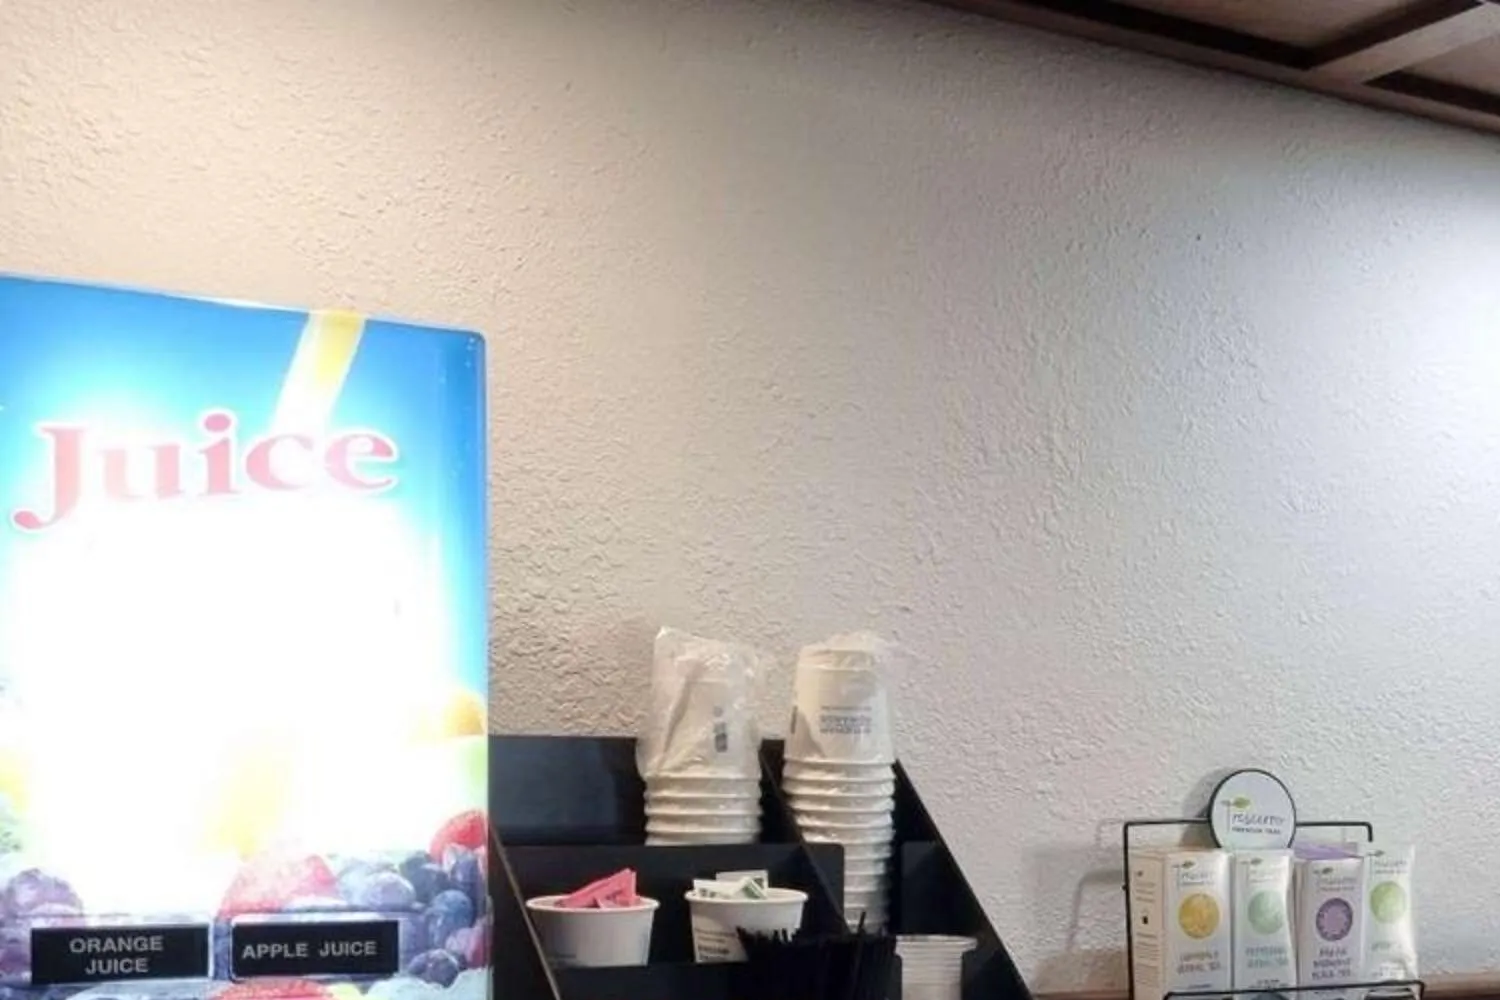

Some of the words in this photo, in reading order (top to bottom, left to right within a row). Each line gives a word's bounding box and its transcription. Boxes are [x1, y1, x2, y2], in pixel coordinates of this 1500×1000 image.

[12, 412, 396, 531] Juice
[68, 934, 165, 954] ORANGE
[241, 942, 309, 960] APPLE
[319, 940, 378, 958] JUICE
[84, 956, 150, 976] JUICE
